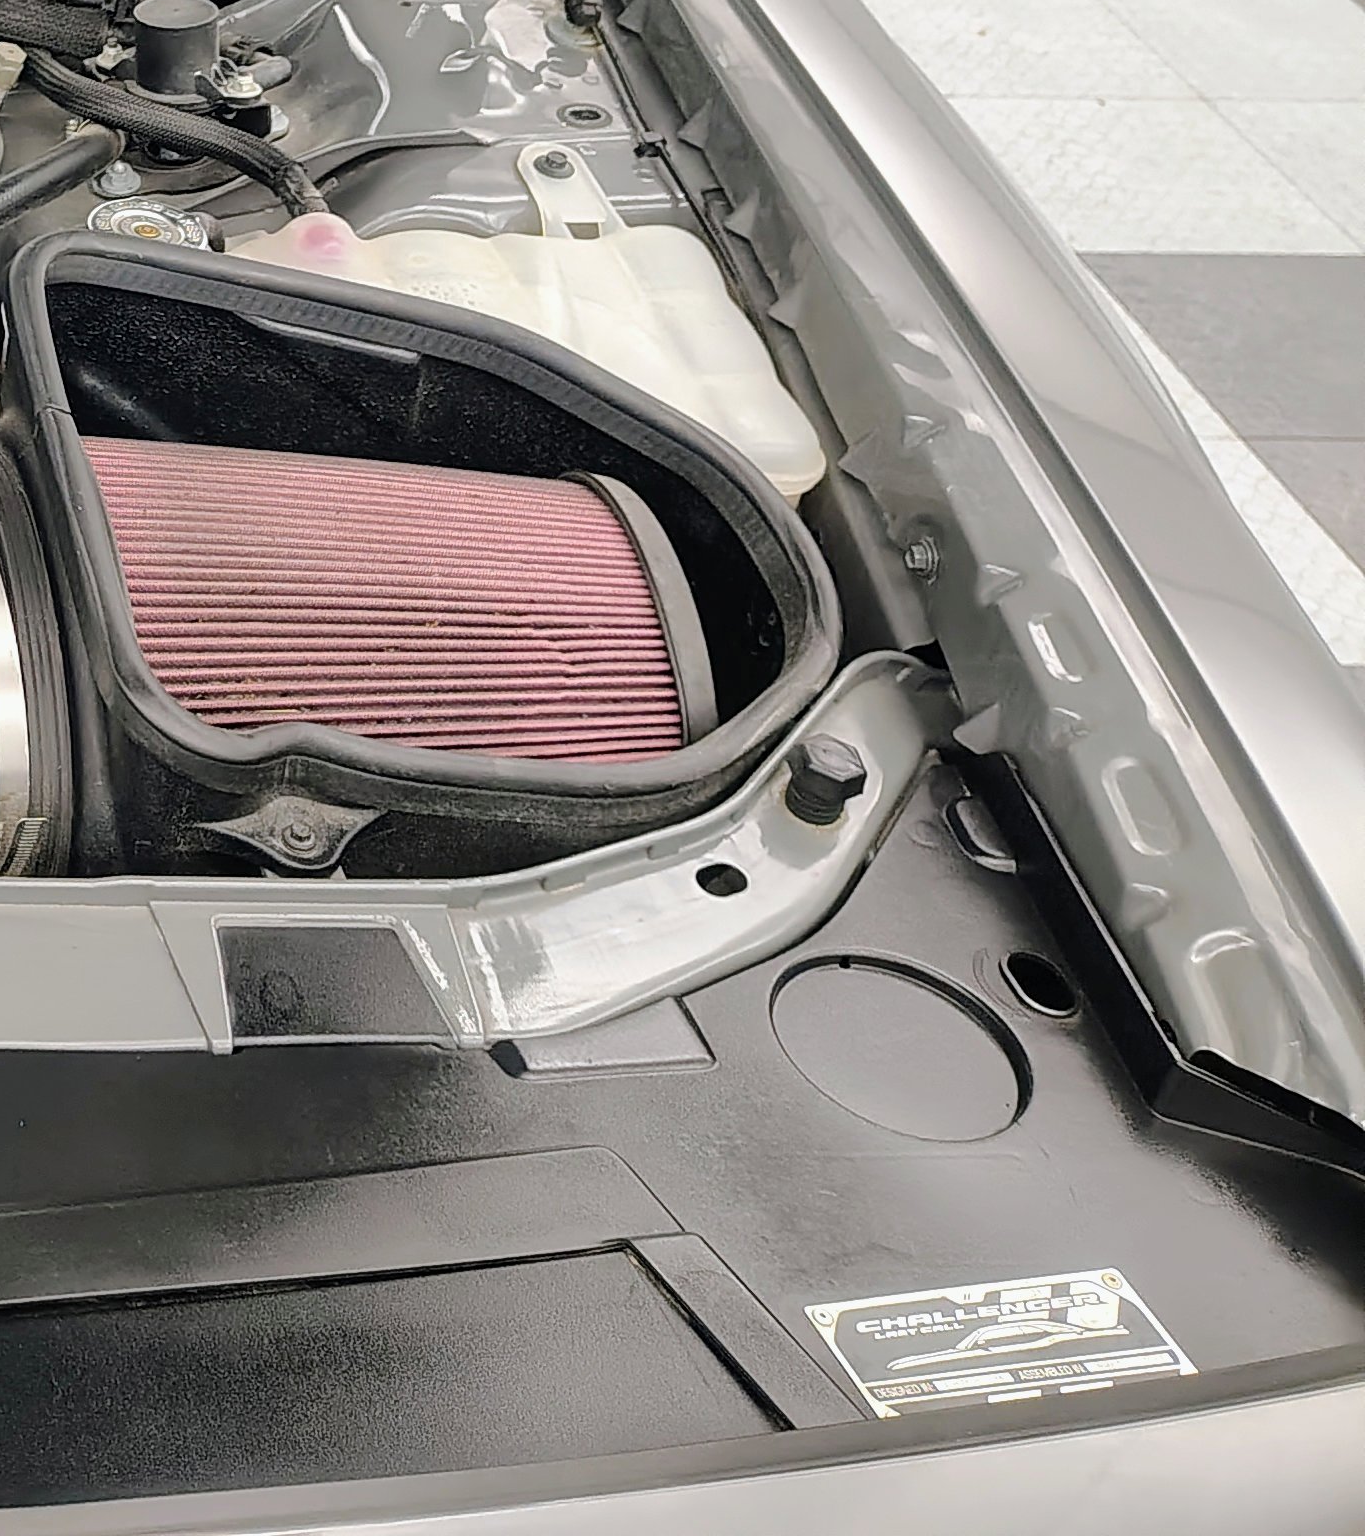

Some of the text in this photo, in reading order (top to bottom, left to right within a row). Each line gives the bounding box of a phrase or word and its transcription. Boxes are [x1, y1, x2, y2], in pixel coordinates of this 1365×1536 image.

[856, 1292, 1107, 1333] CHALLENGER
[919, 1322, 965, 1334] CALL
[873, 1383, 921, 1399] DESIGNED
[1018, 1364, 1074, 1381] ASSEMBLED
